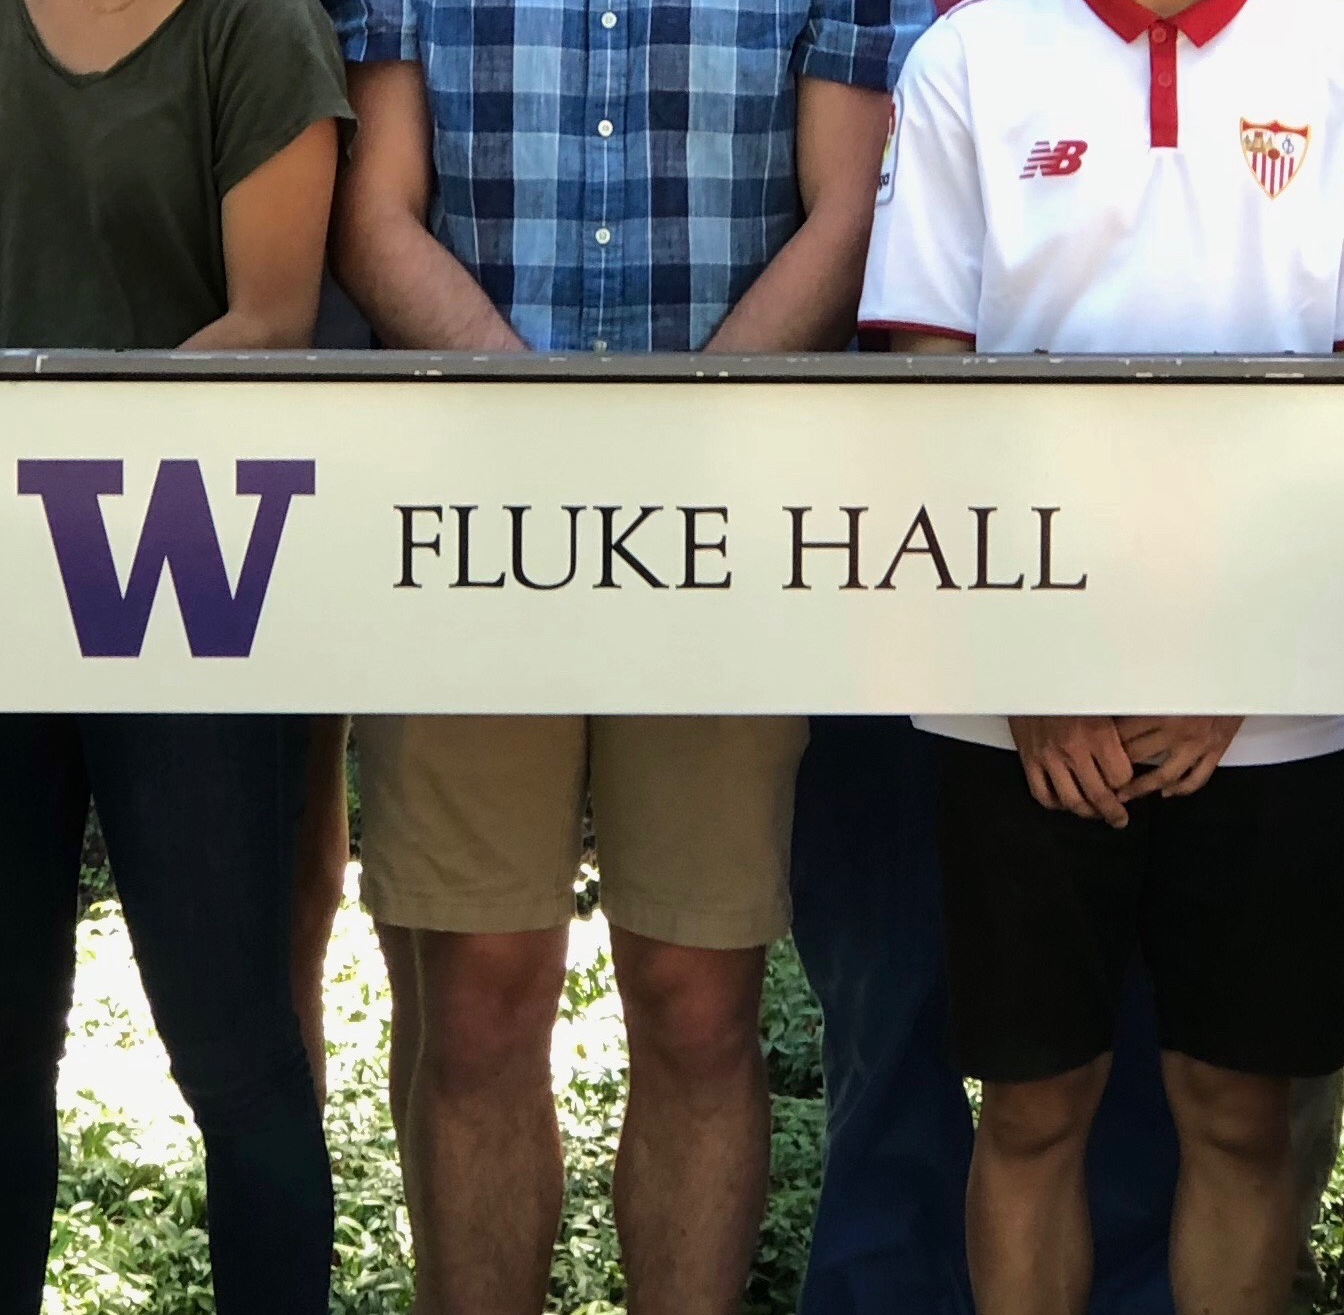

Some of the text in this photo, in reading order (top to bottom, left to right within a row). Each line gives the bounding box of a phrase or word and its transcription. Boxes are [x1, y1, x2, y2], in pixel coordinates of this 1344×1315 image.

[17, 459, 316, 658] W
[393, 505, 1087, 591] FLUKE HALL
